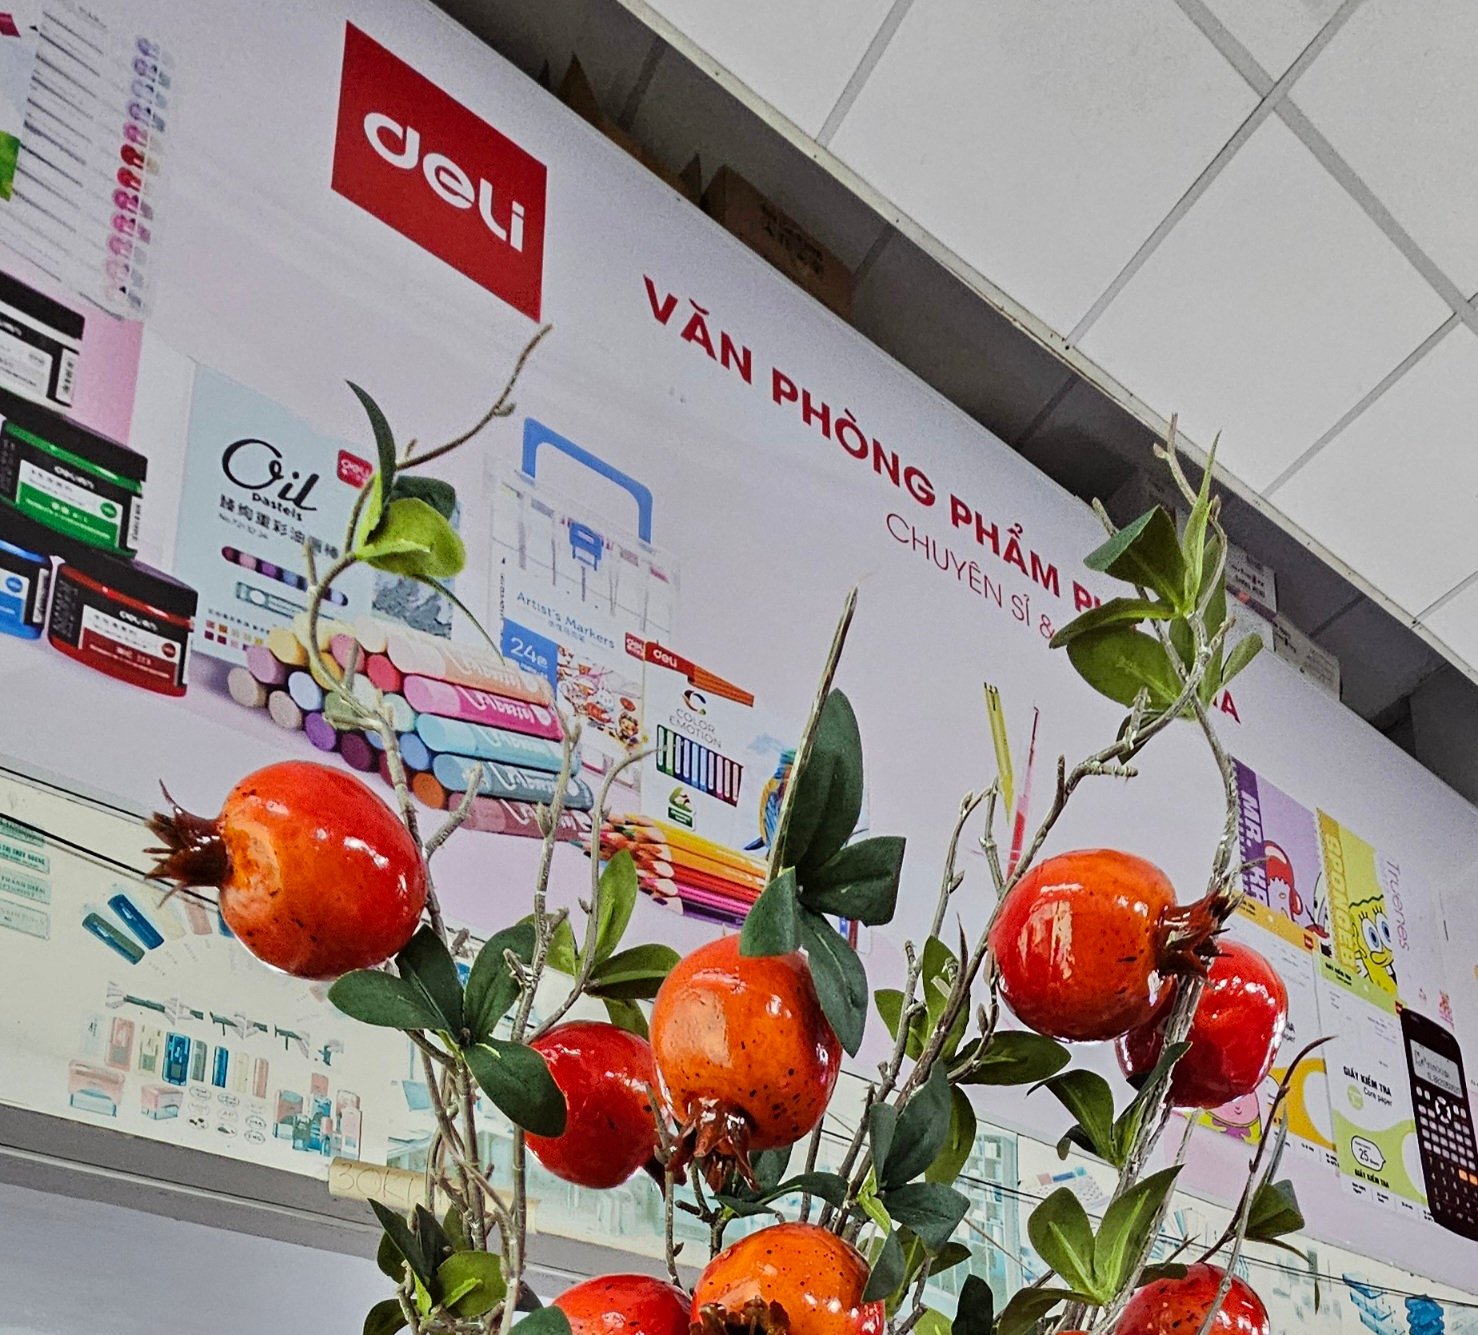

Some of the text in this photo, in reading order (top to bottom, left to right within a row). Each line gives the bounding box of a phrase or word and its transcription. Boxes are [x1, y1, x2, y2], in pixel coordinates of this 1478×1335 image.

[364, 112, 525, 253] deli
[643, 274, 752, 385] VĂN
[772, 367, 936, 507] PHÒNG
[950, 493, 1060, 598] PHẨM
[222, 438, 320, 512] Oil
[886, 513, 1002, 608] CHUYÊN
[1011, 593, 1031, 626] SỈ
[516, 591, 563, 624] Artist's
[564, 615, 615, 650] Markers
[653, 648, 678, 669] deli
[669, 714, 722, 749] EMOTION
[676, 707, 716, 734] COLOR
